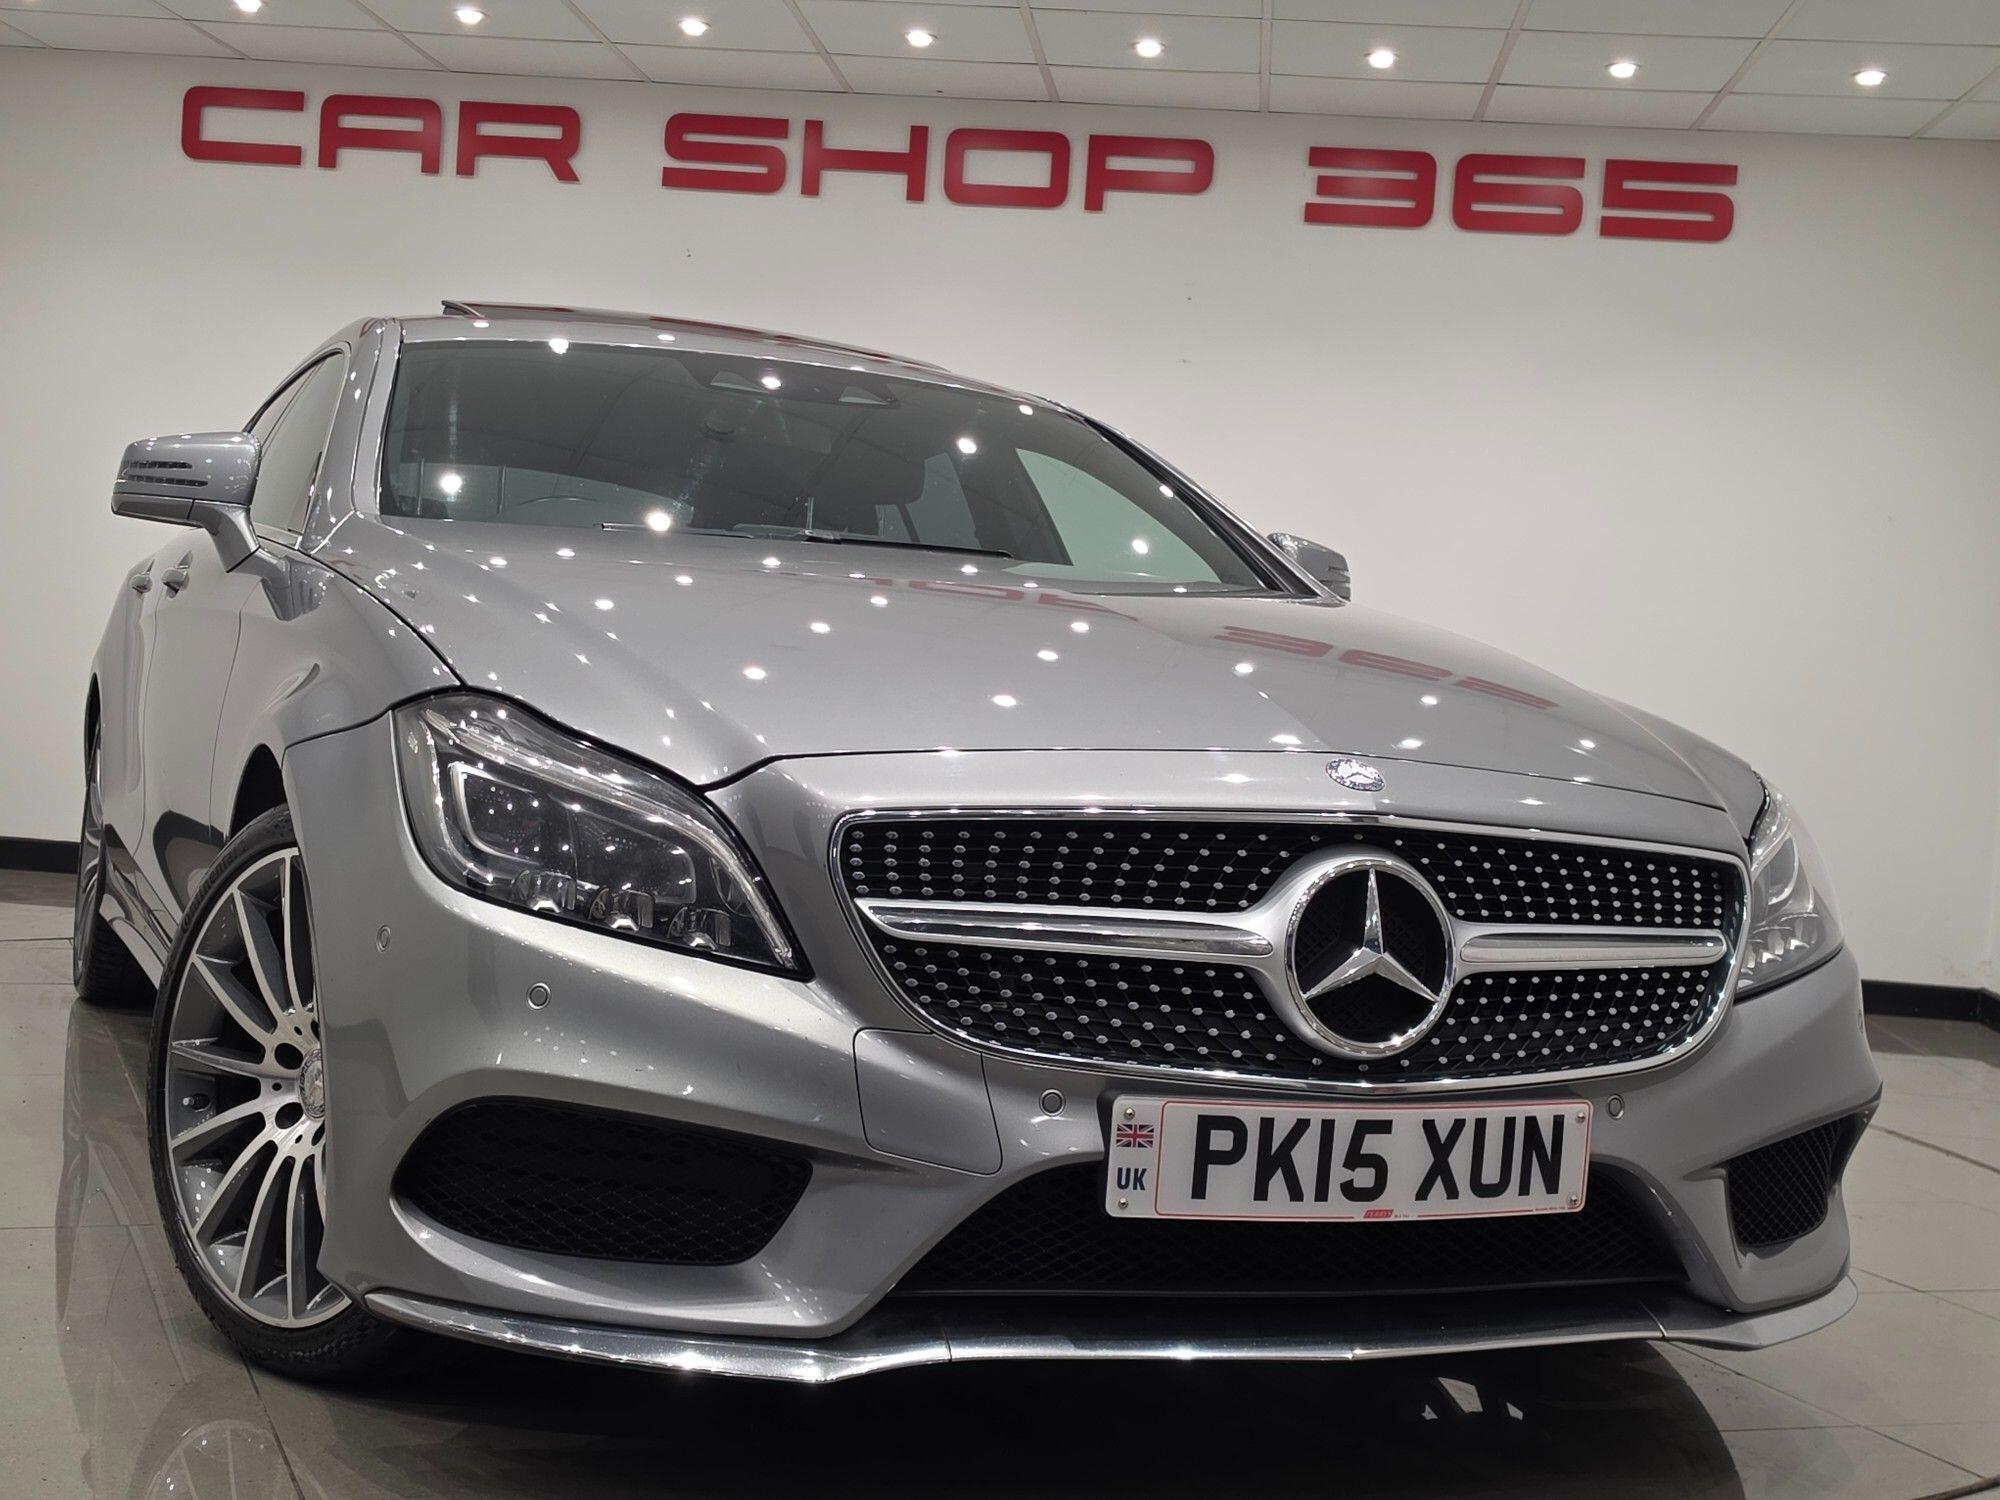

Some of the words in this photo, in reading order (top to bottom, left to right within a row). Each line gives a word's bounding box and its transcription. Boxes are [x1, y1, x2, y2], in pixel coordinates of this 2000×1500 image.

[181, 85, 580, 183] CAR
[661, 112, 1215, 212] SHOP
[1303, 146, 1738, 242] 365
[1116, 1166, 1148, 1191] UK
[1190, 1113, 1394, 1203] PK15
[1414, 1113, 1566, 1202] XUN
